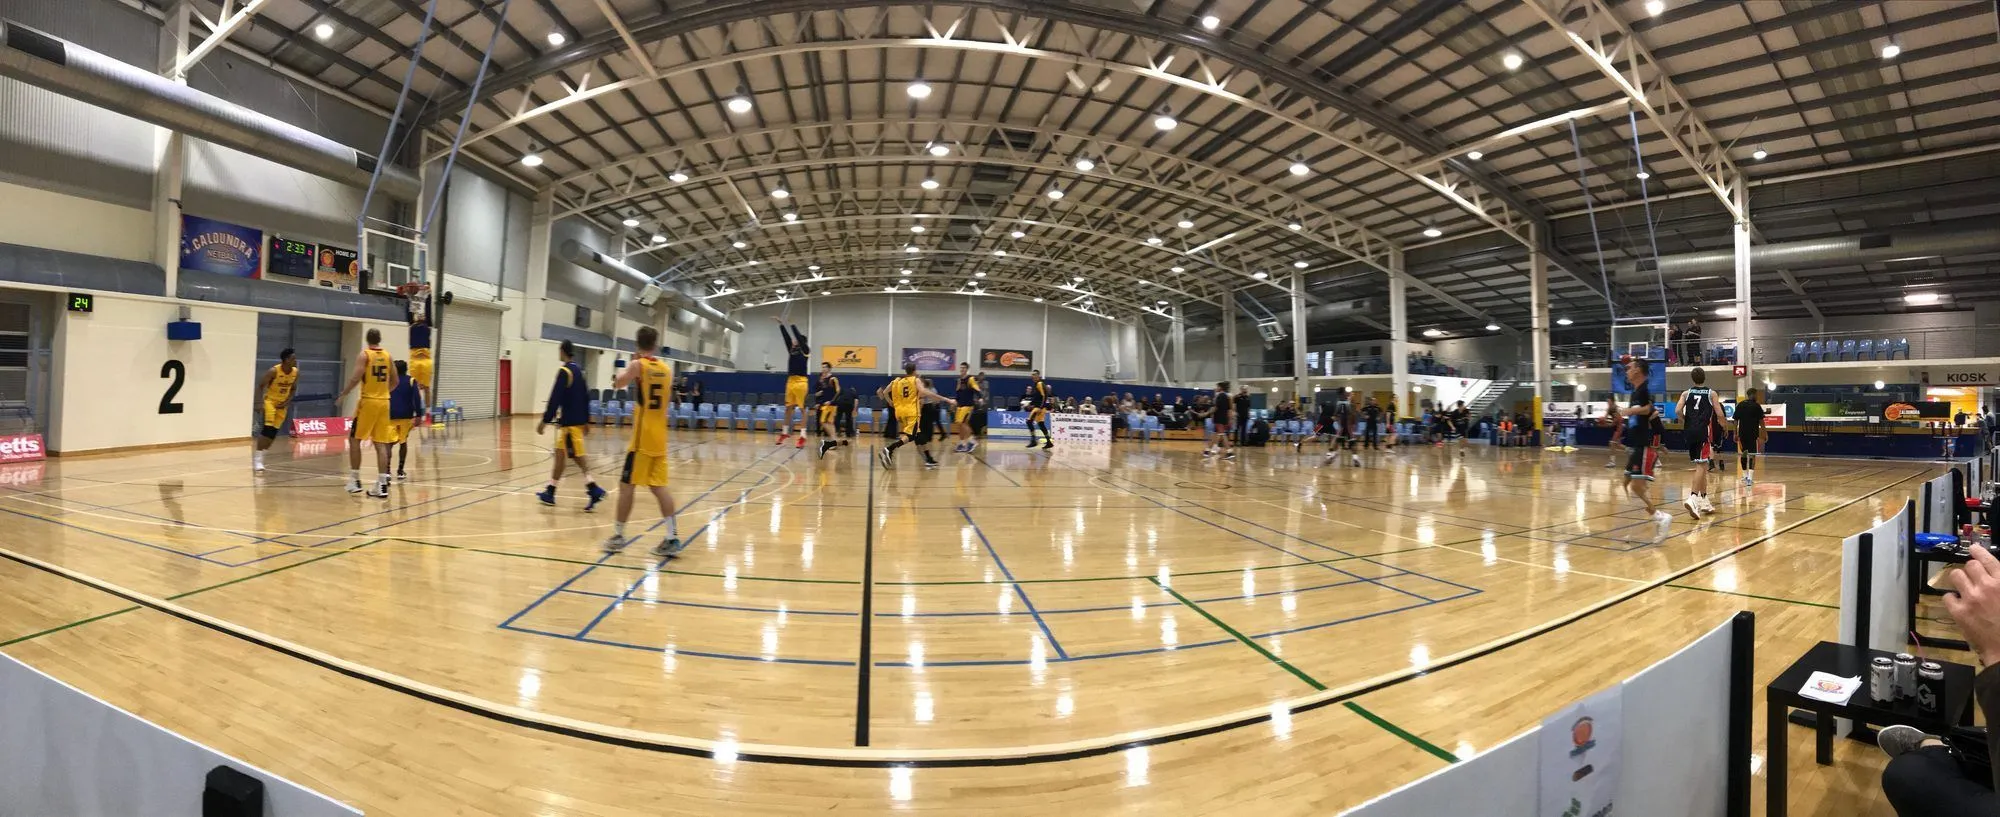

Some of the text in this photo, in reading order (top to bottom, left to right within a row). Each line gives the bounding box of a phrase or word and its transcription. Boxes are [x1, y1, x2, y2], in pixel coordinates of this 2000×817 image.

[192, 232, 253, 259] CALOUNDRA
[286, 241, 306, 255] 2:33
[207, 249, 239, 262] NETBALL
[335, 250, 350, 258] HOME
[74, 297, 89, 309] 24
[372, 365, 387, 382] 45
[1947, 372, 1988, 383] KIOSK
[158, 359, 186, 415] 2
[902, 386, 909, 398] 6
[649, 383, 663, 409] 5
[1693, 394, 1702, 410] 7
[299, 419, 327, 434] jetts
[0, 436, 40, 454] etts
